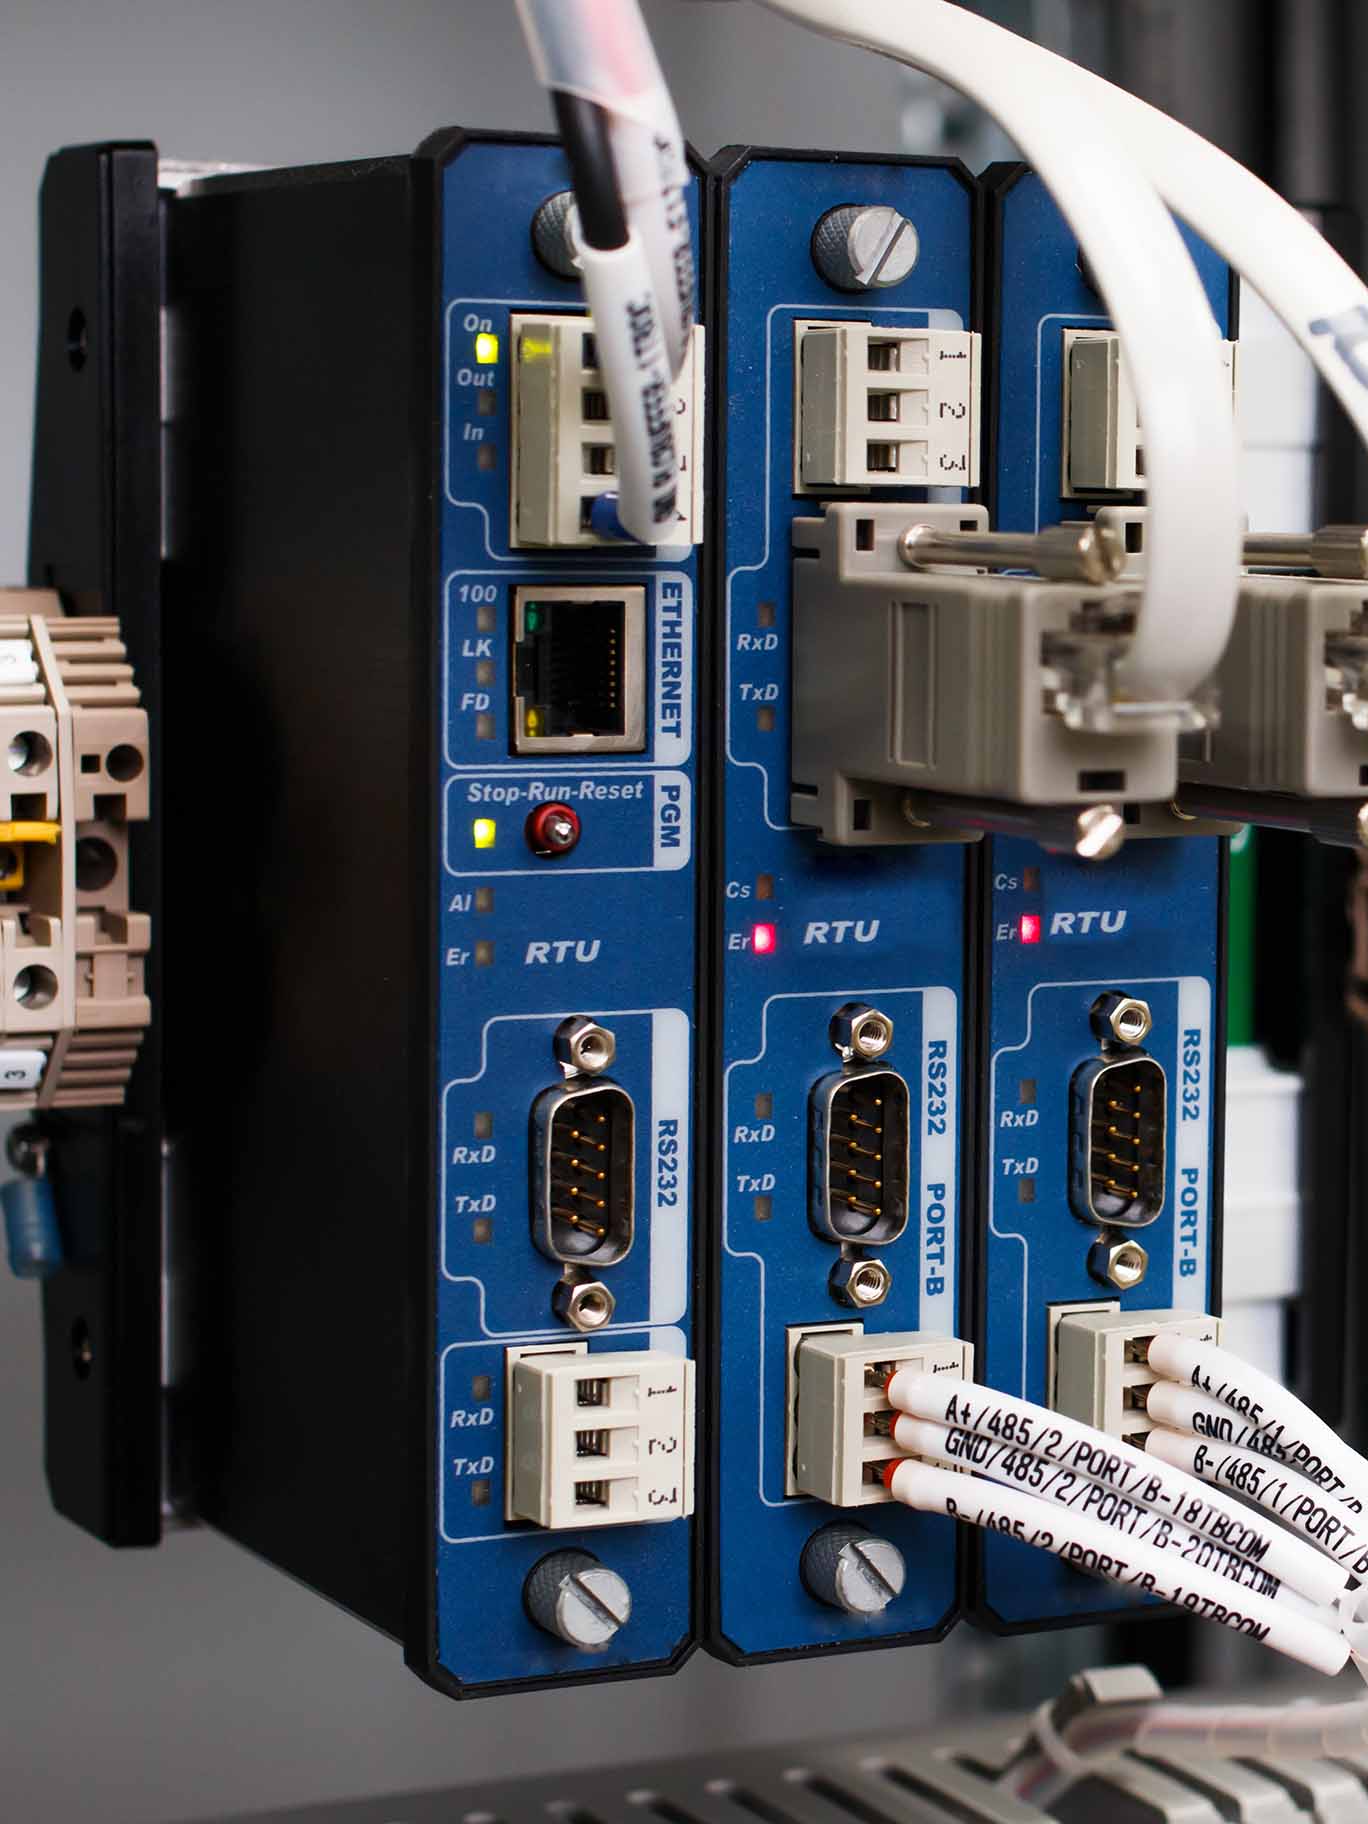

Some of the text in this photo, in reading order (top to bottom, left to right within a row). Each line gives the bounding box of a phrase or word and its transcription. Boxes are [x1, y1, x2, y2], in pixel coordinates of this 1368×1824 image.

[463, 313, 493, 332] On
[456, 367, 495, 388] Out
[463, 423, 484, 442] In
[458, 585, 497, 602] 100
[462, 640, 494, 658] LK
[736, 634, 779, 651] RxD
[661, 580, 683, 739] ETHERNET
[460, 693, 490, 711] FD
[739, 684, 780, 701] TxD
[467, 780, 645, 804] Stop-Run-Reset
[660, 784, 682, 849] PGM
[725, 881, 752, 899] Cs
[993, 873, 1019, 891] Cs
[1049, 910, 1127, 936] RTU
[727, 933, 752, 951] Er
[803, 920, 881, 946] RTU
[995, 924, 1019, 942] Er
[446, 948, 470, 967] Er
[524, 940, 601, 965] RTU
[1000, 1109, 1040, 1128] RxD
[733, 1125, 776, 1143] RxD
[452, 1145, 497, 1164] RxD
[1179, 1028, 1202, 1278] RS232 PORT-B
[656, 1119, 679, 1207] RS232
[925, 1039, 949, 1297] RS232 PORT-B
[1002, 1158, 1040, 1176] TxD
[736, 1174, 777, 1192] TxD
[455, 1195, 497, 1213] TxD
[450, 1409, 495, 1428] RxD
[453, 1456, 495, 1475] TxD
